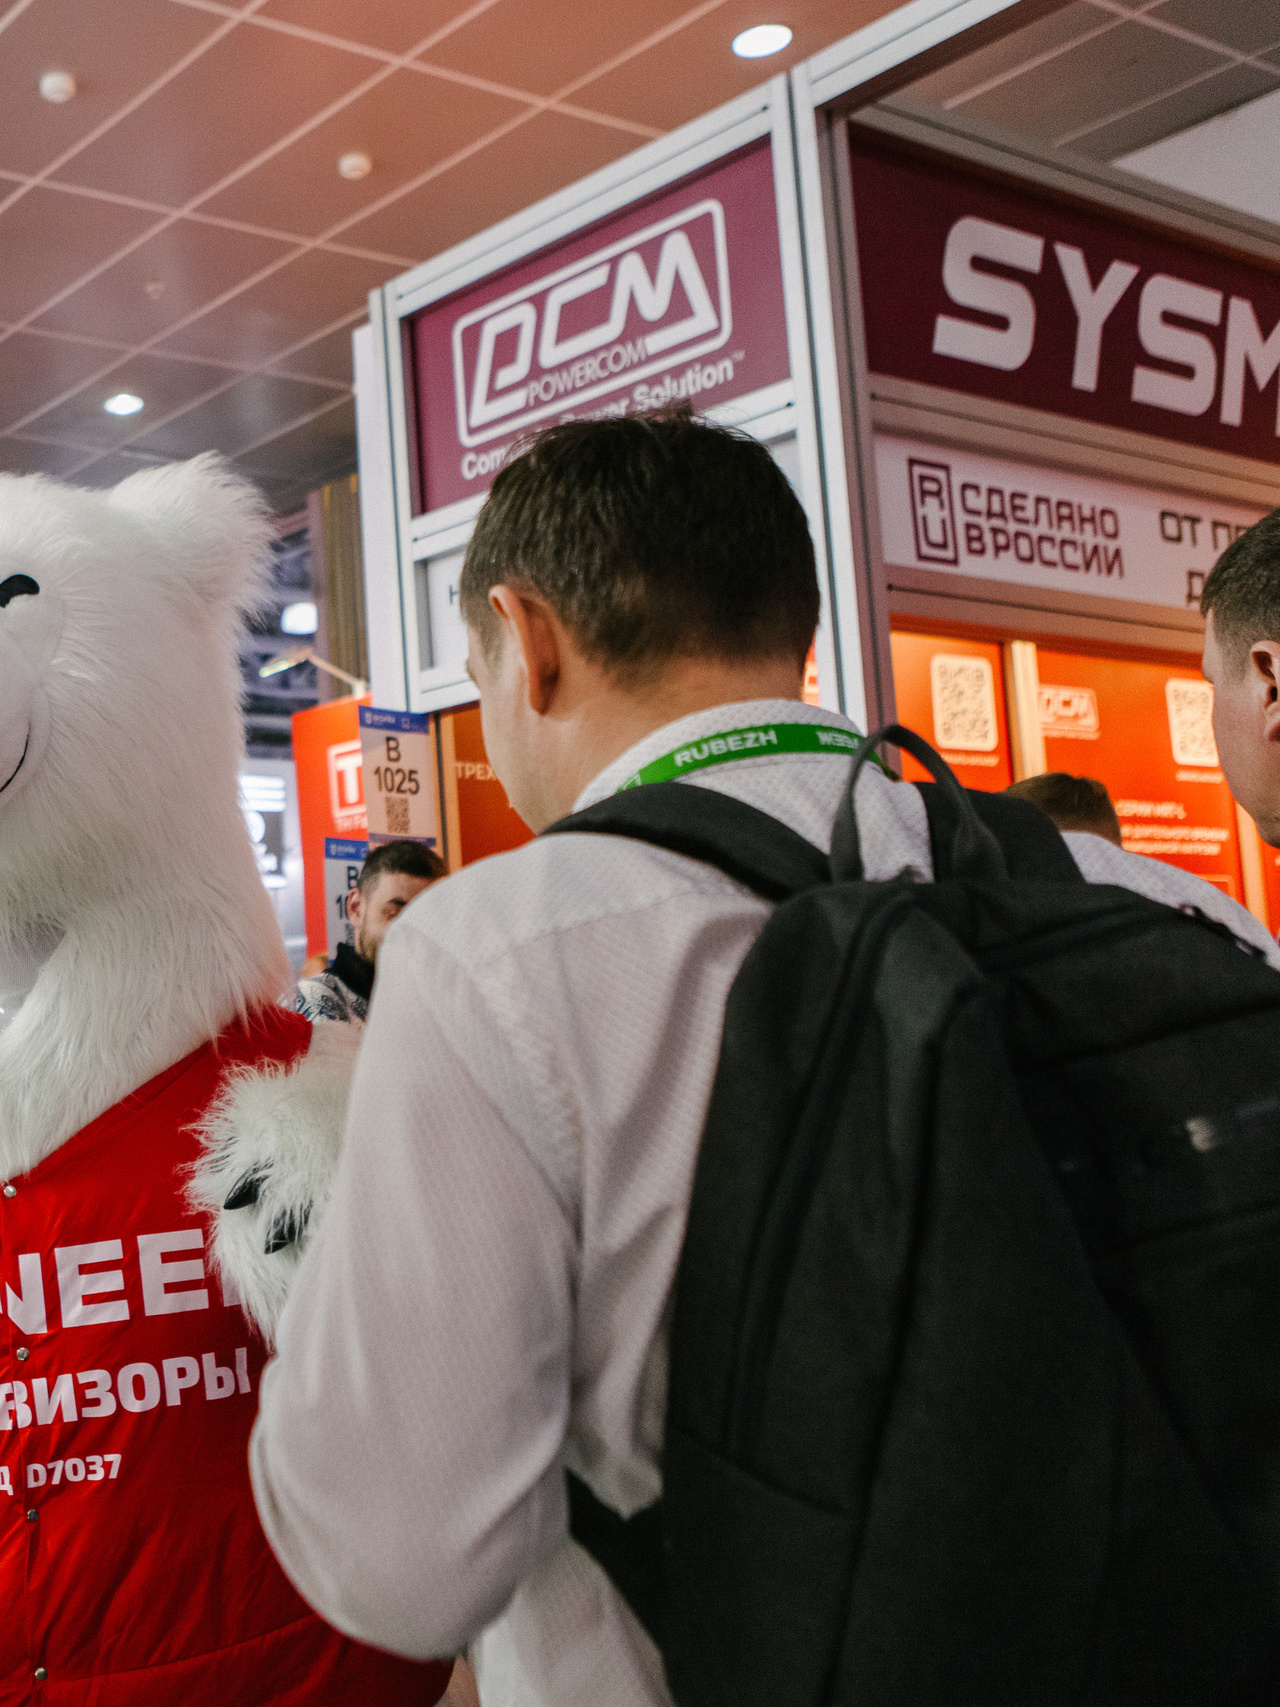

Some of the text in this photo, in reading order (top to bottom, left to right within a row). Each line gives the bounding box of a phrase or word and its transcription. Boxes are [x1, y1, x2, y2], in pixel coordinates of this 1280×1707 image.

[525, 338, 647, 406] POWERCOM
[960, 482, 1120, 540] СДЕЛАНО
[1160, 510, 1201, 547] ОТ
[385, 736, 401, 762] B
[673, 730, 778, 767] RUBEZH
[373, 766, 420, 795] 1025
[28, 1454, 121, 1488] D7037
